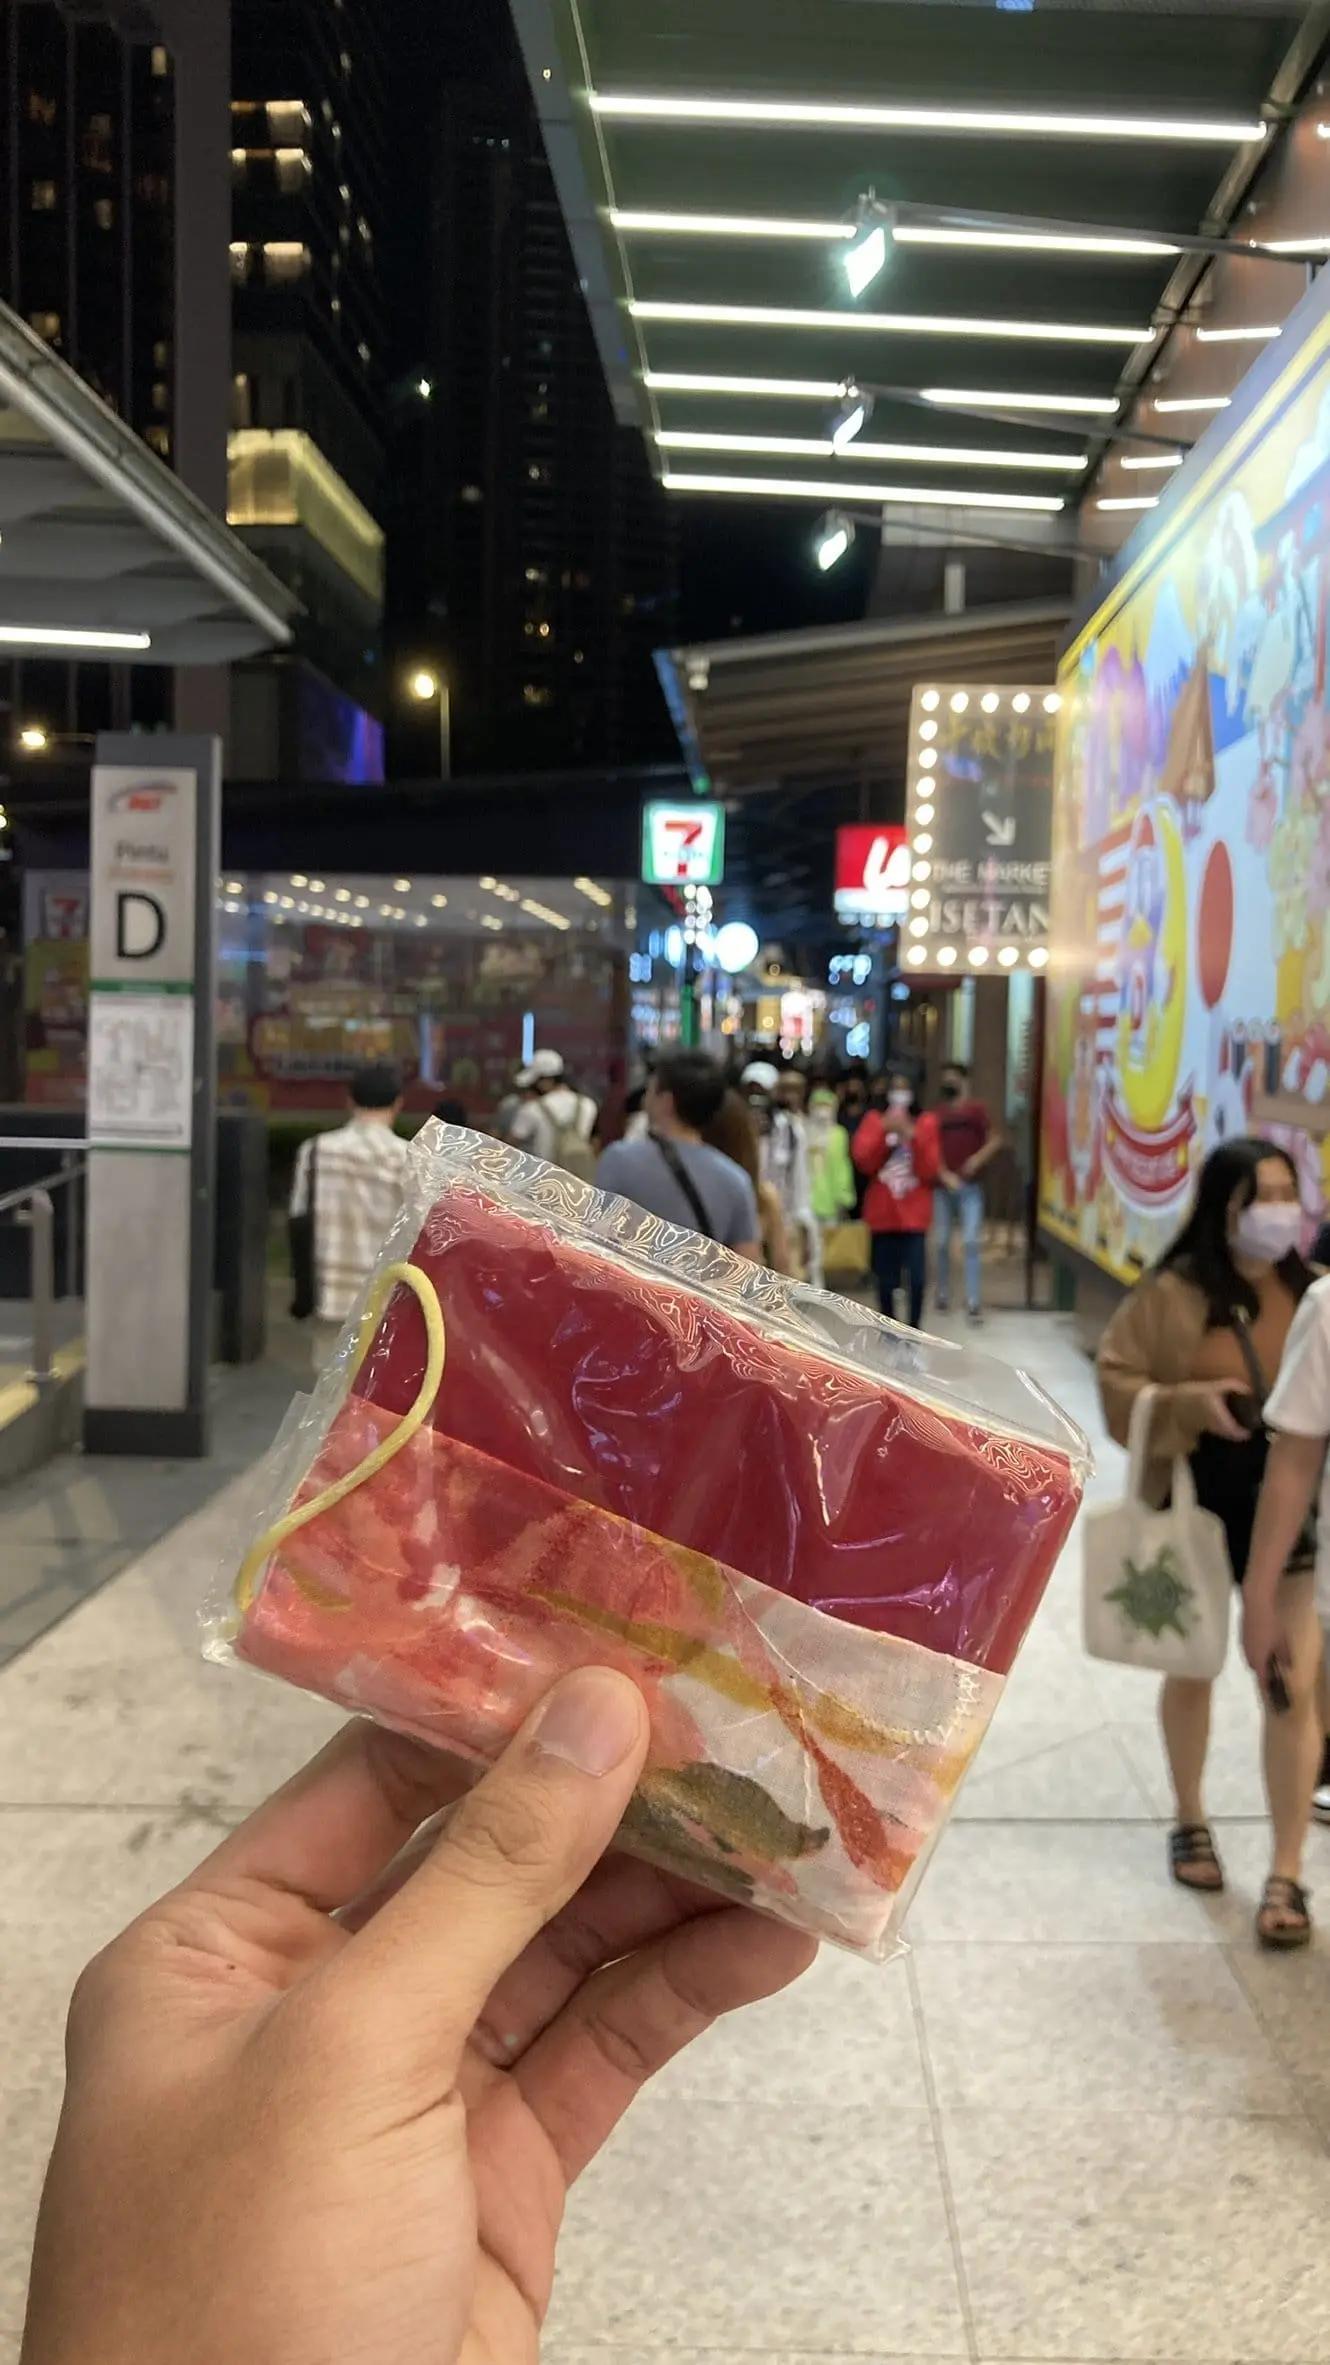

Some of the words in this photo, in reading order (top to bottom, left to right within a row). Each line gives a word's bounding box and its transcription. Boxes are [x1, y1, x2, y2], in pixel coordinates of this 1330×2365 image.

[664, 820, 703, 877] 7
[977, 861, 1050, 885] MARKE
[116, 891, 168, 960] D
[929, 899, 1050, 936] ISETAN
